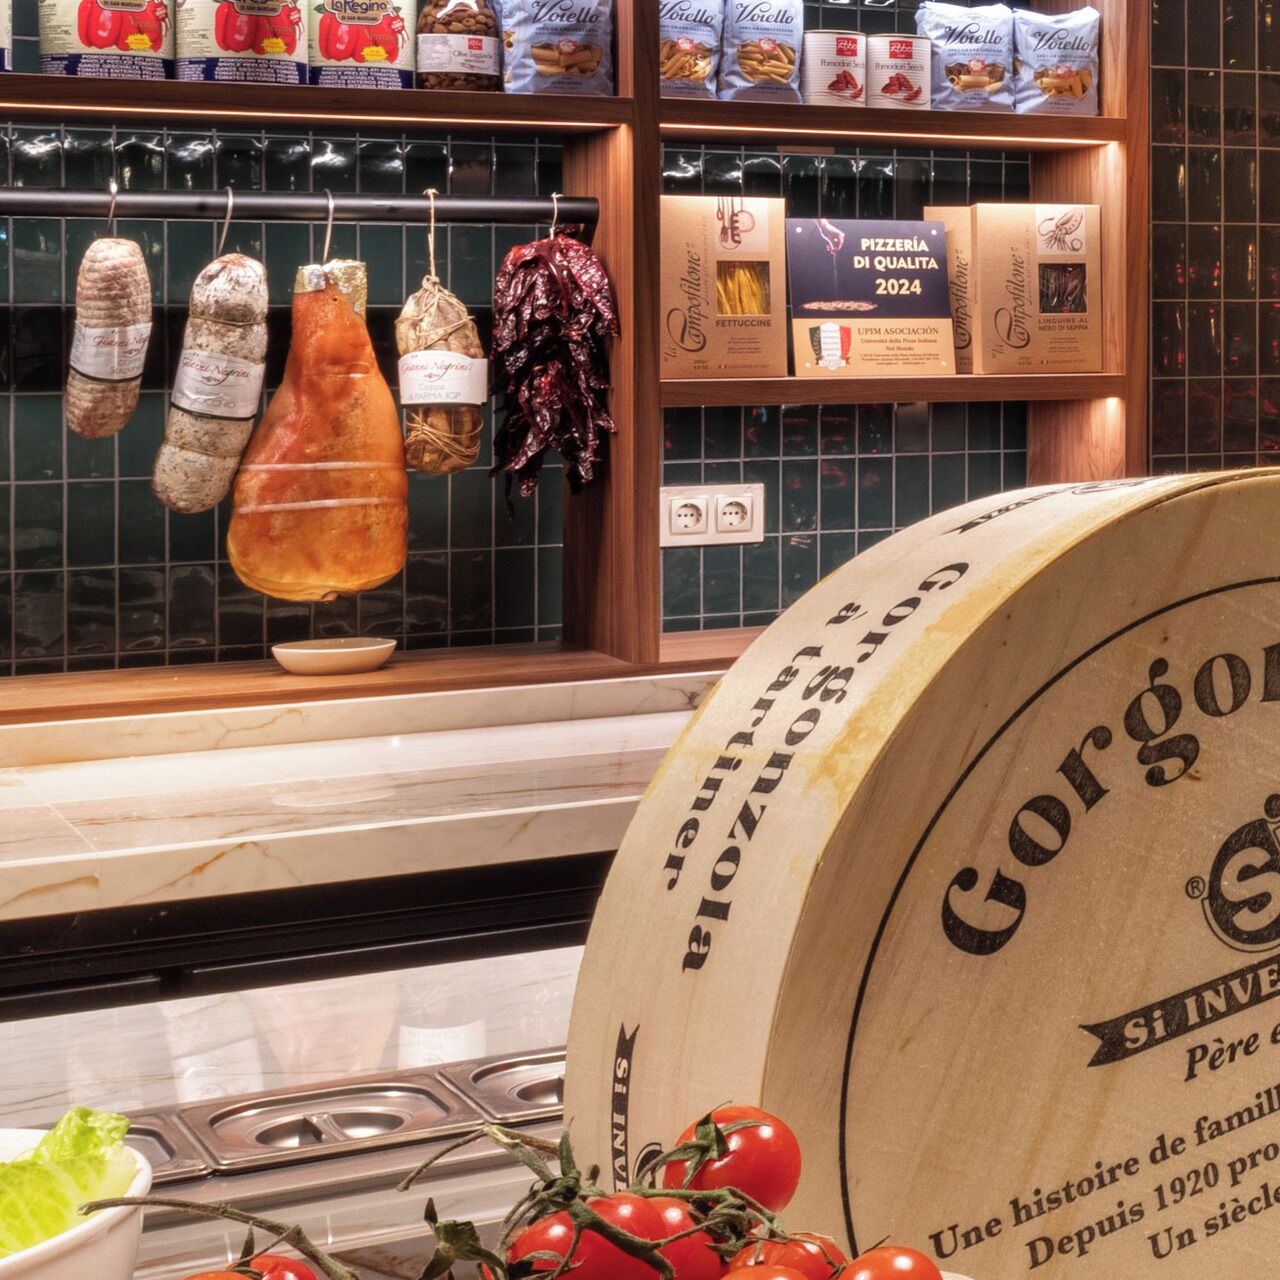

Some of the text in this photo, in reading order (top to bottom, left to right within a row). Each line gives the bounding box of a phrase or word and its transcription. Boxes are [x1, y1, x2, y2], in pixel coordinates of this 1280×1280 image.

[531, 0, 600, 24] Voiello
[660, 0, 714, 25] Voiello
[735, 1, 794, 25] Voiello
[944, 23, 1003, 47] Voiello
[1033, 28, 1090, 52] Voiello
[860, 236, 930, 251] PIZZERÍA
[853, 256, 939, 272] DI QUALITA
[875, 278, 922, 295] 2024
[715, 319, 772, 328] FETTUCCINE
[857, 325, 939, 335] UPIM ASOCIACIÓN
[1038, 317, 1089, 325] LINGUINE AL
[211, 364, 250, 380] Negrini
[662, 645, 825, 892] tartiner
[681, 560, 970, 973] Gorgonzola
[1123, 1007, 1168, 1048] Si
[1182, 1032, 1260, 1082] Père
[615, 1057, 629, 1094] Si
[929, 1215, 1004, 1263] Une
[1009, 1153, 1140, 1226] histoire
[1147, 1126, 1188, 1166] de
[1024, 1201, 1145, 1273] Depuis
[1153, 1162, 1221, 1213] 1920
[1147, 1227, 1198, 1262] Un
